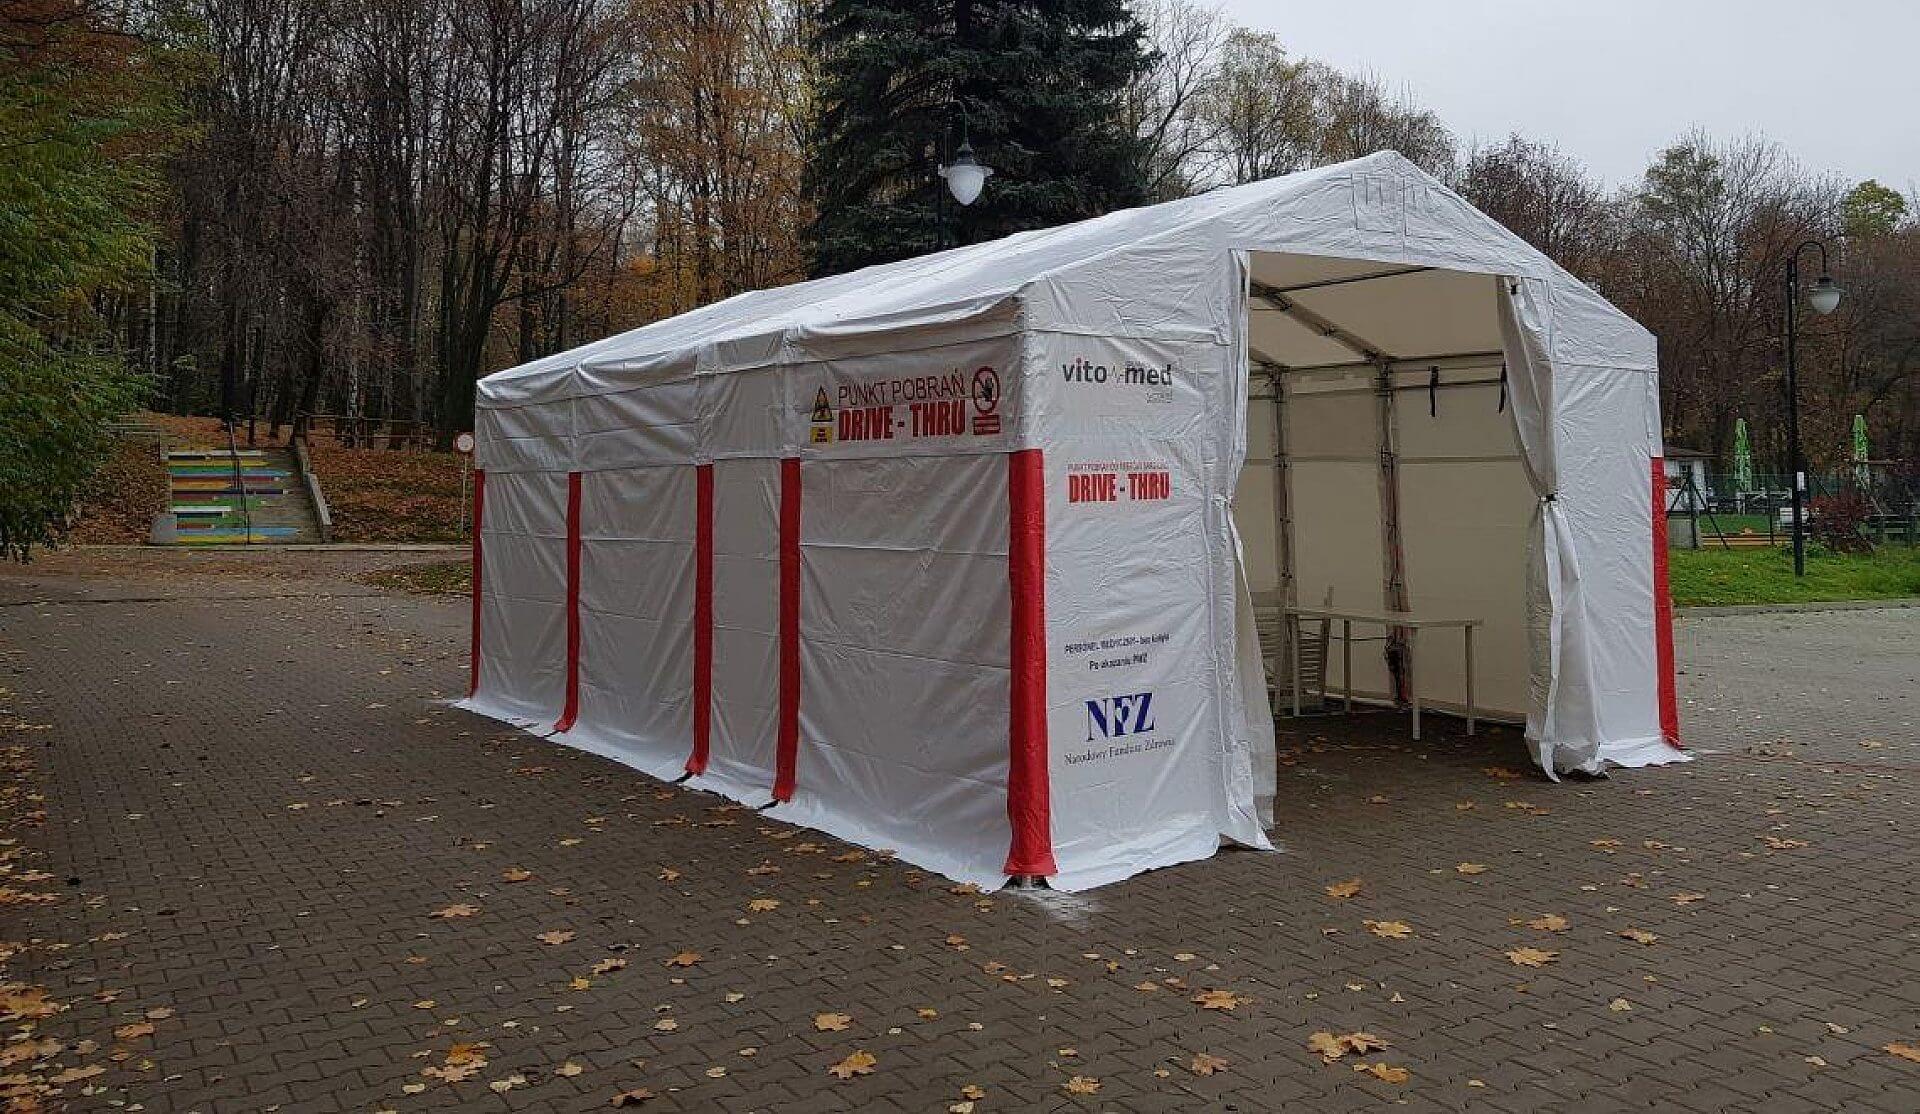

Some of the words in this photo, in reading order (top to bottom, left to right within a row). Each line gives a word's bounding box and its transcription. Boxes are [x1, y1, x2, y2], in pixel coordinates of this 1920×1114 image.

[838, 381, 888, 405] PUNKT
[892, 369, 966, 401] POBRAŃ
[838, 405, 894, 441] DRIVE
[909, 400, 966, 438] THRU
[1068, 473, 1117, 503] DRIVE
[1128, 472, 1170, 500] THRU
[1085, 692, 1155, 742] NFZ
